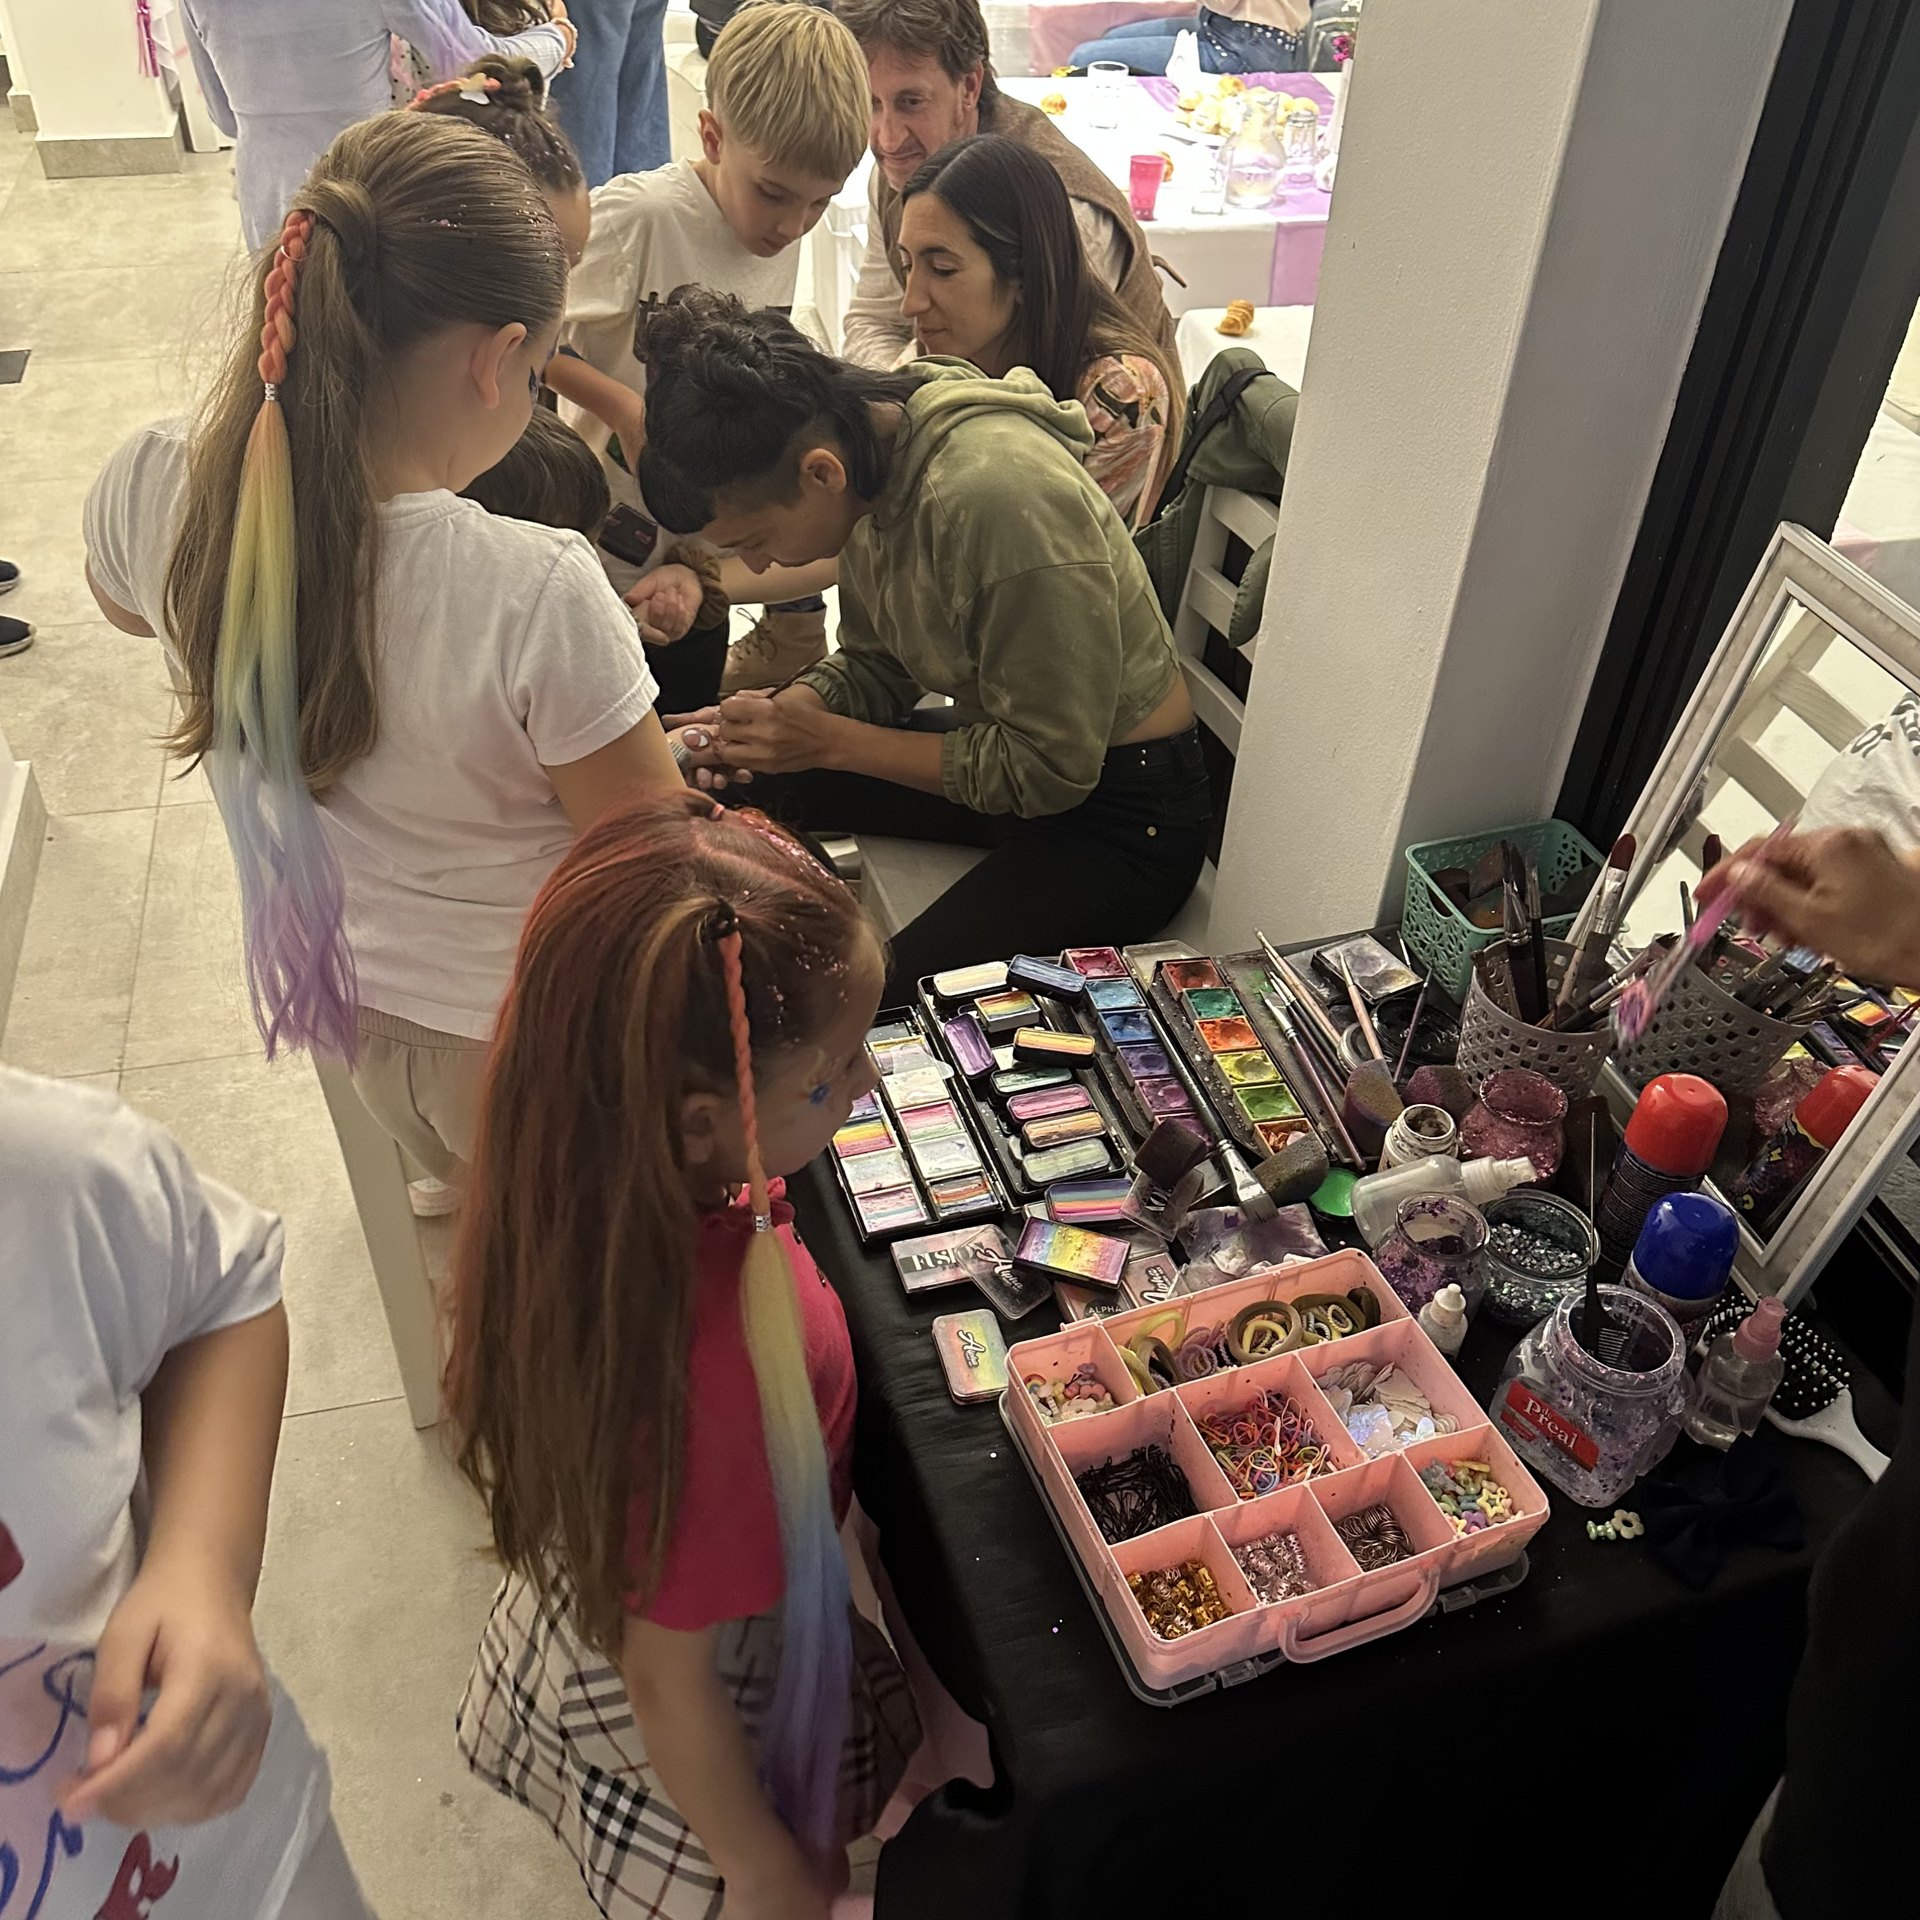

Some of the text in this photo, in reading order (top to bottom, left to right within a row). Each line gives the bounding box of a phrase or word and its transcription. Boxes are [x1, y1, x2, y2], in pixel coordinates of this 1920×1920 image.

[976, 1247, 1024, 1290] Alpha
[1088, 1305, 1122, 1314] ALPHA
[1525, 1398, 1577, 1449] Preal
